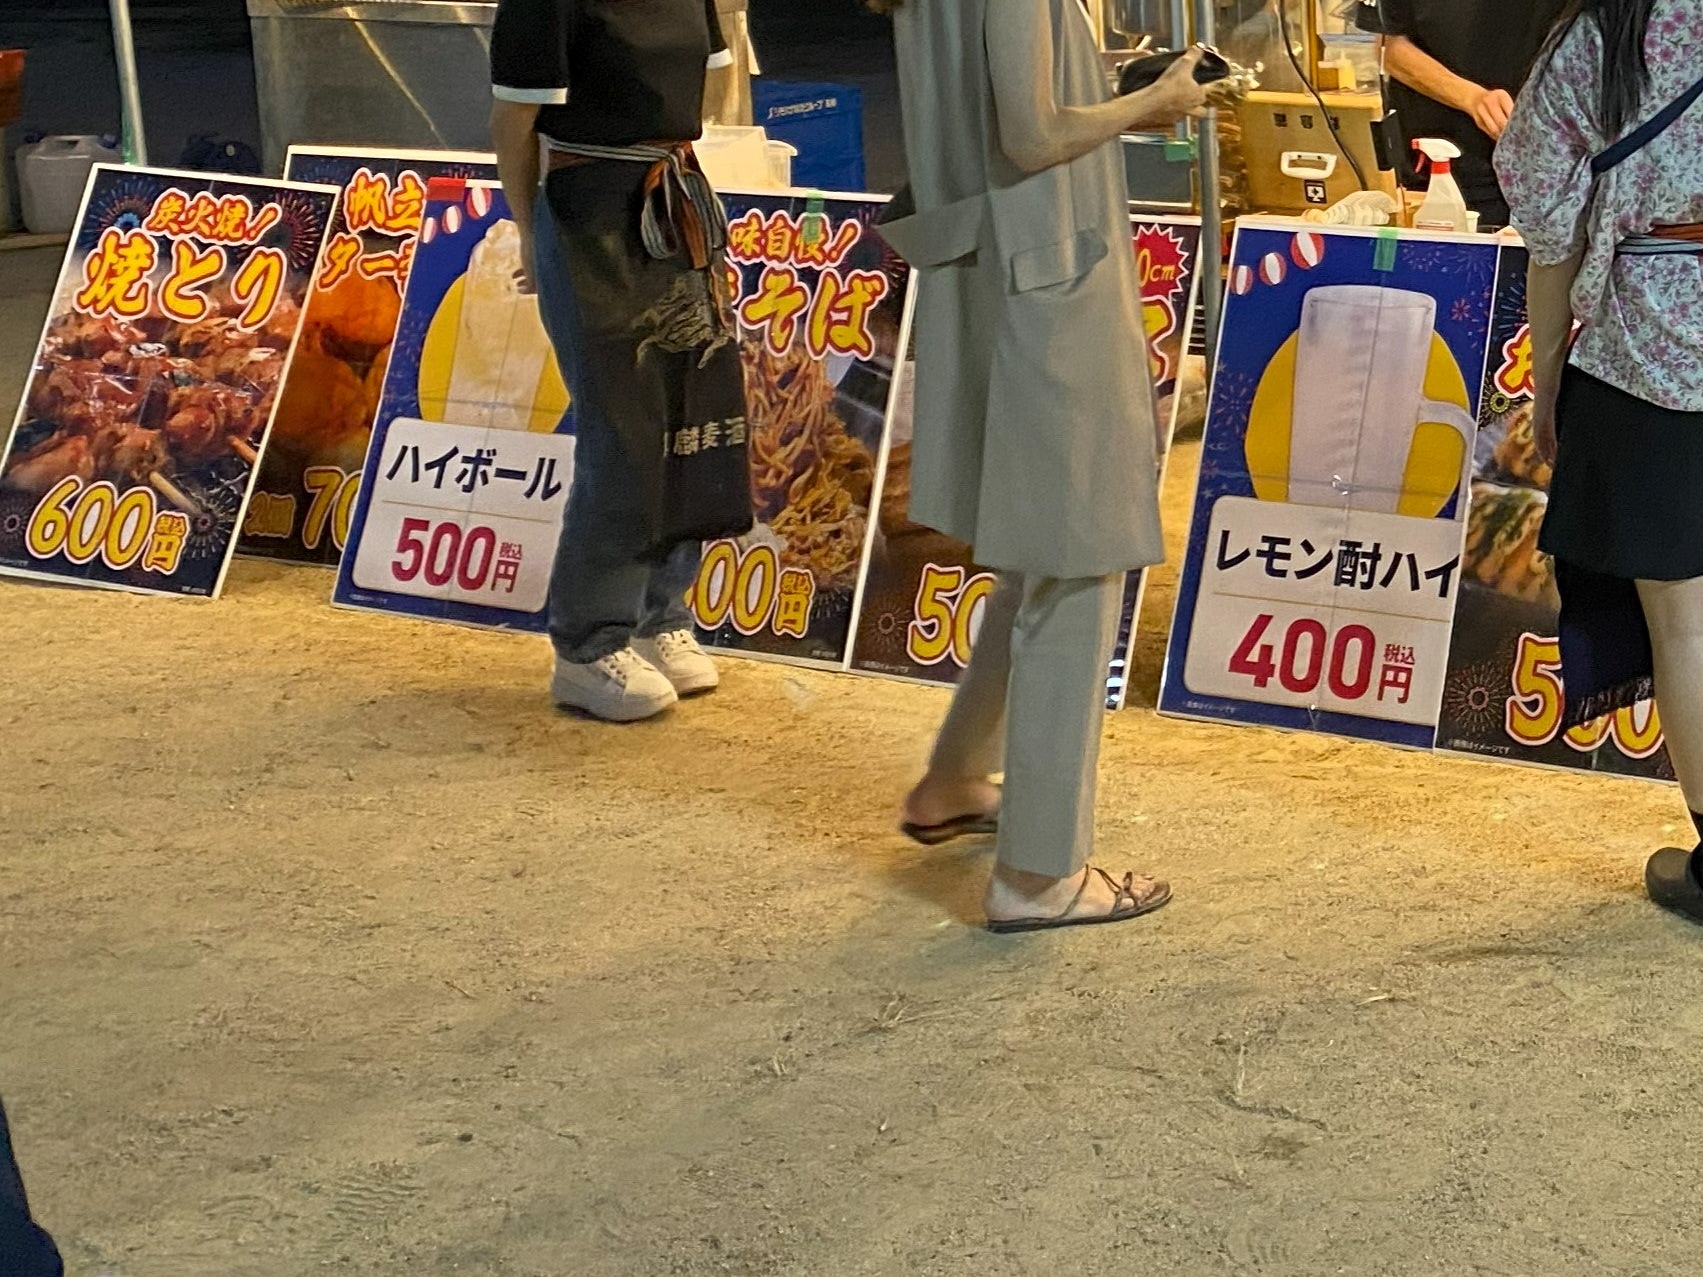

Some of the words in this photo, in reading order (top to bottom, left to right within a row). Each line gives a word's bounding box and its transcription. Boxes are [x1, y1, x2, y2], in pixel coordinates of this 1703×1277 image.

[145, 190, 280, 242] 炭火焼！
[345, 169, 426, 234] 帆立
[75, 228, 285, 331] 焼とり
[1138, 248, 1175, 288] 0cm
[664, 416, 746, 456] 麟麦酒
[386, 445, 562, 501] ハイボール
[685, 539, 812, 637] 00円
[1216, 529, 1460, 598] レモン酎ハイ
